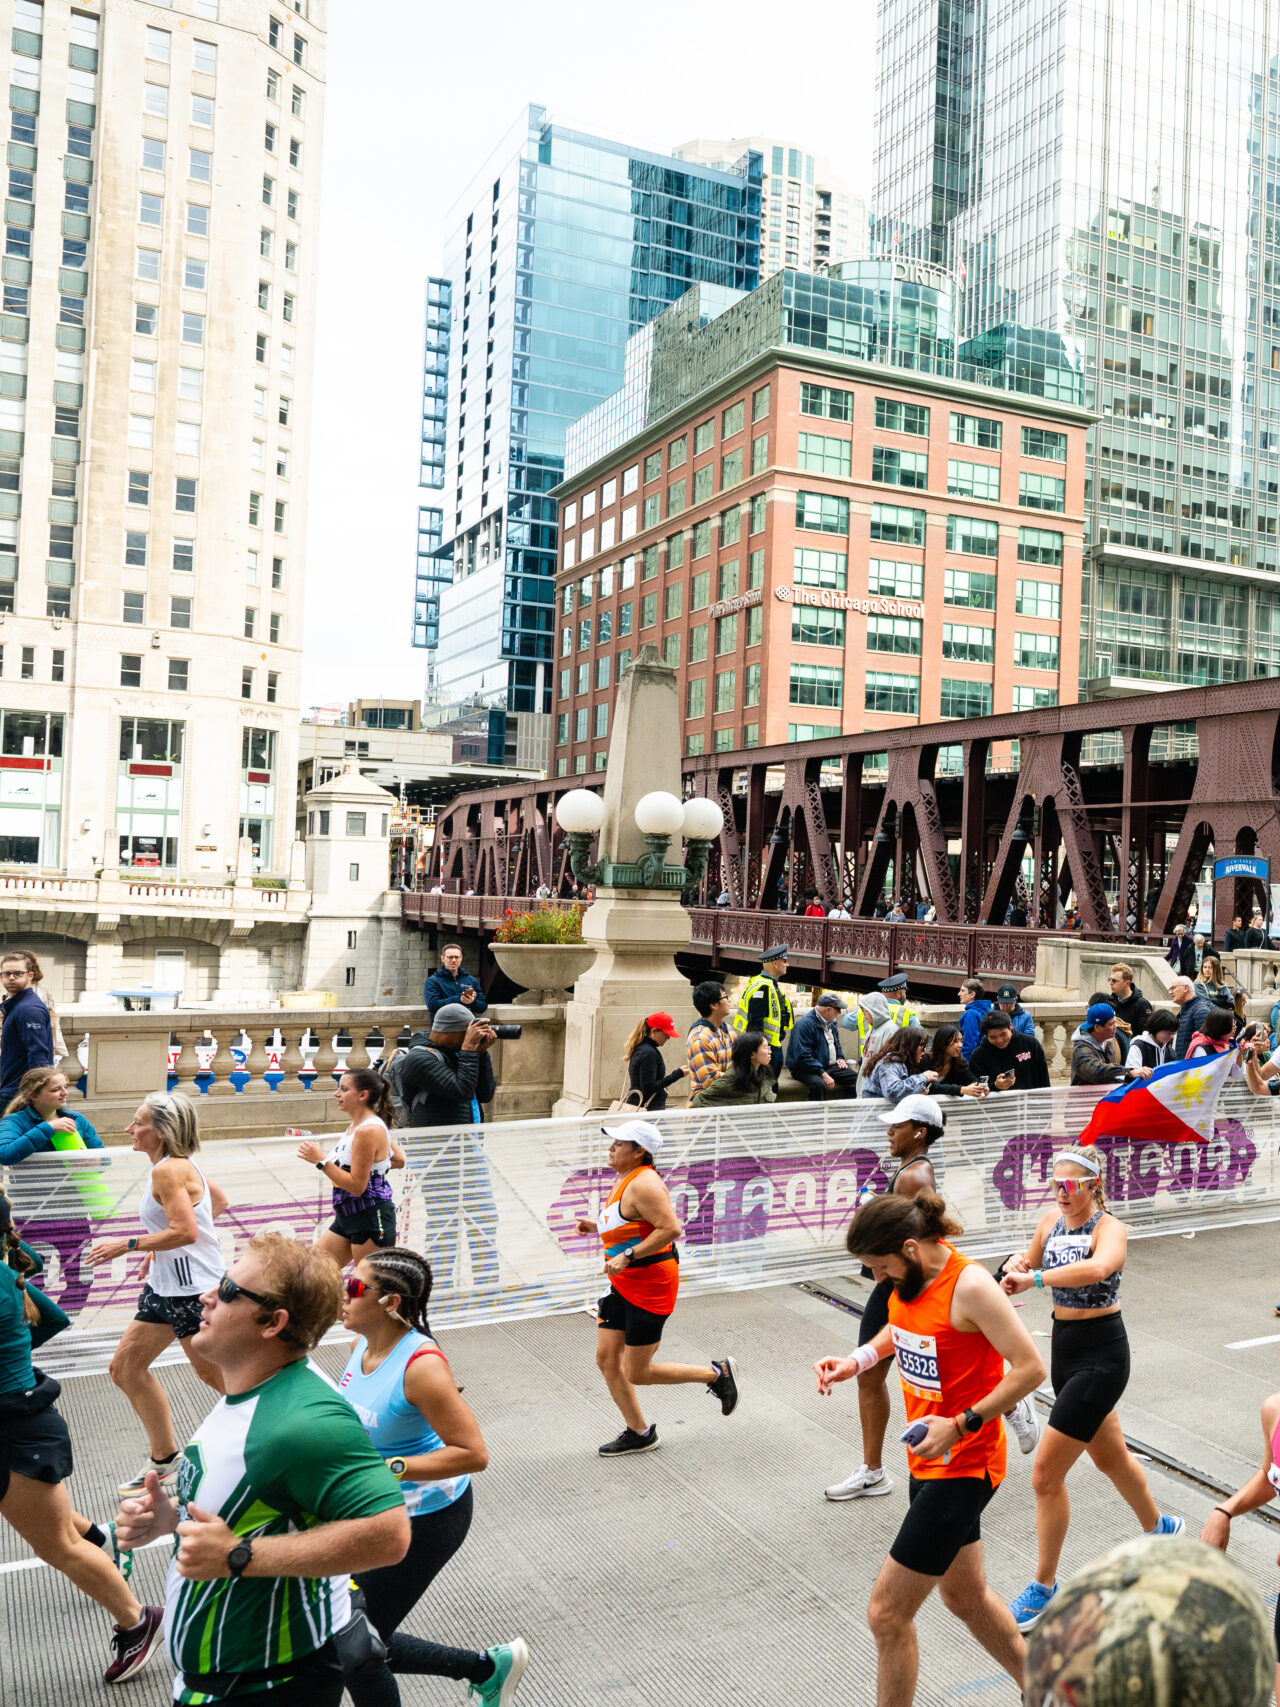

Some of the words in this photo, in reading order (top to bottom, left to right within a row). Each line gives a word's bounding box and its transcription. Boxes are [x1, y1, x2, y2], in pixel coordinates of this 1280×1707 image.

[792, 588, 816, 605] The
[818, 591, 877, 614] Chicago
[880, 599, 925, 618] School
[1226, 863, 1257, 875] RIVERWALK
[902, 1350, 938, 1377] 55328
